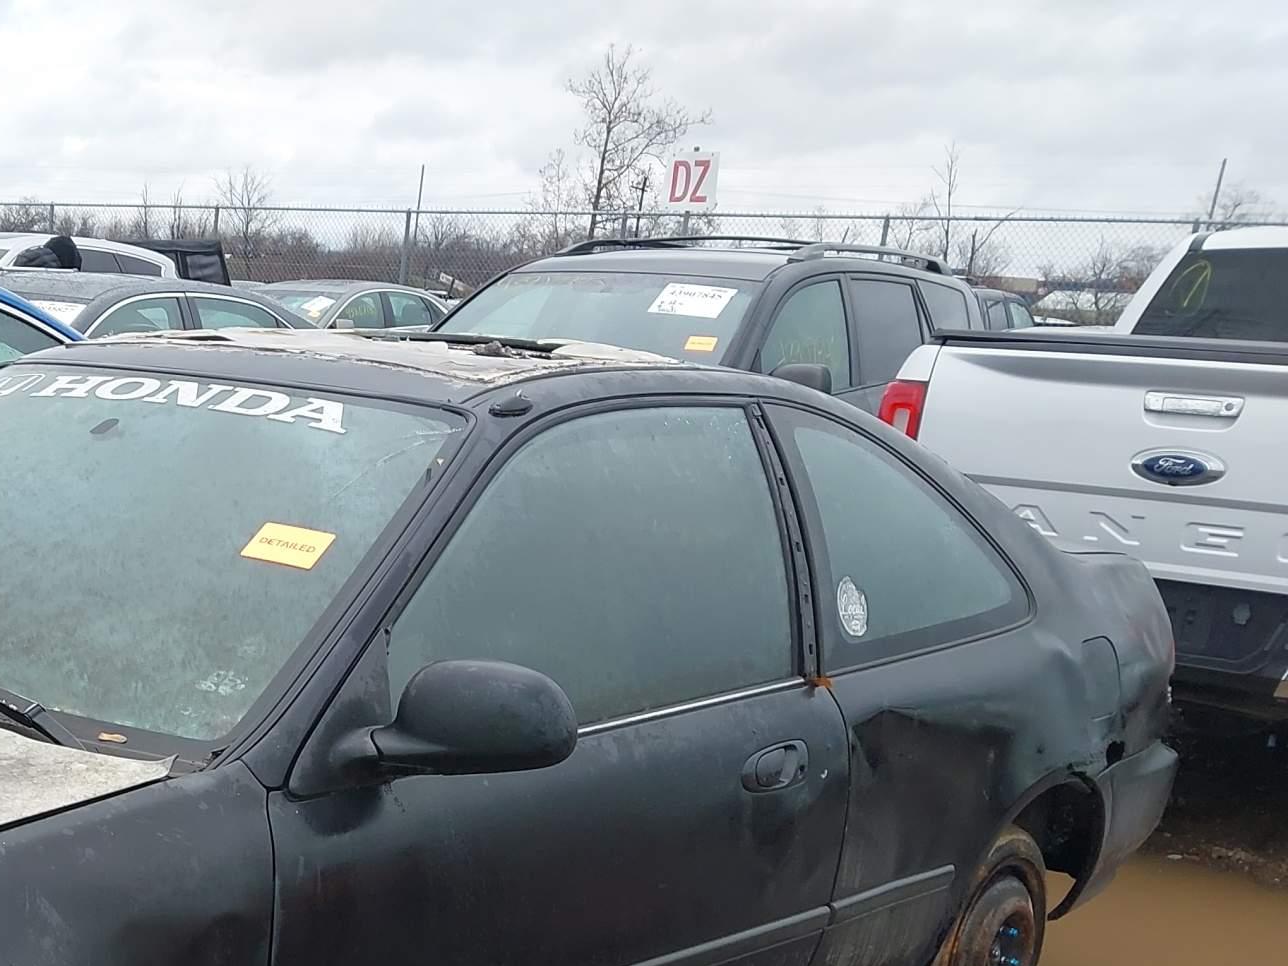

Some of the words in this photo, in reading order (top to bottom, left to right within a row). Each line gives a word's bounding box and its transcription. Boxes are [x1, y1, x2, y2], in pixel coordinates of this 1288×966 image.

[668, 159, 712, 203] DZ
[29, 374, 347, 434] HONDA
[1153, 457, 1195, 475] Ford
[258, 536, 317, 554] DETAILED
